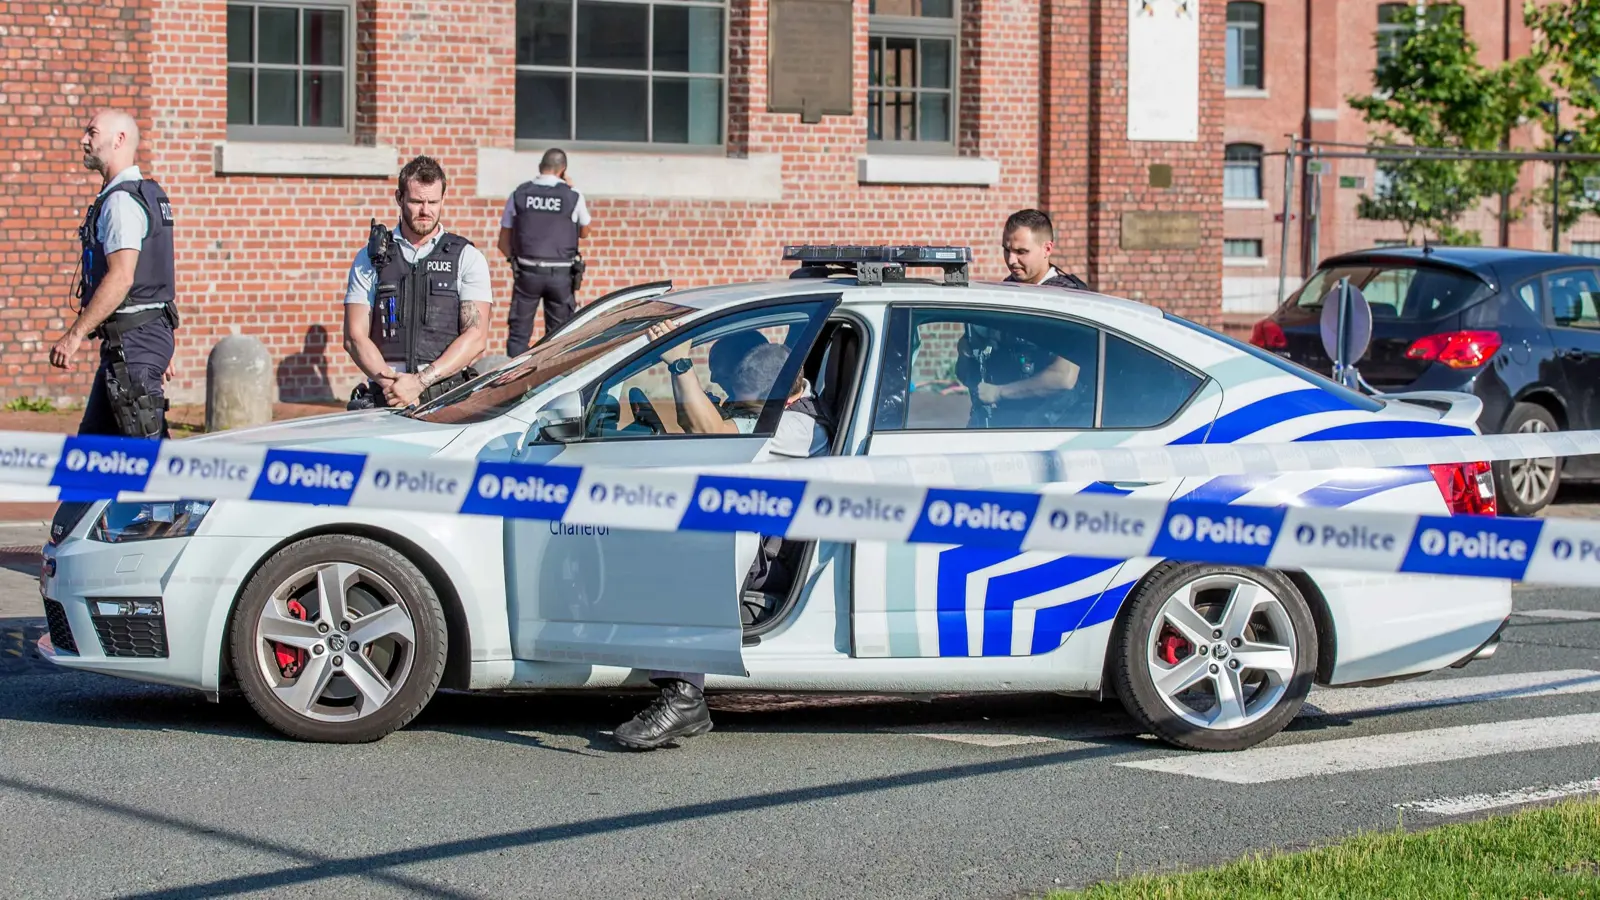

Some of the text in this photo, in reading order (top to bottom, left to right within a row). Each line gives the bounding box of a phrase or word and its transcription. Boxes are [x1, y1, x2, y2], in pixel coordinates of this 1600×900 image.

[526, 196, 561, 211] POLICE
[427, 261, 452, 272] POLICE
[0, 446, 49, 468] olice
[87, 449, 150, 476] Police
[189, 457, 248, 482] Police
[289, 461, 354, 490] Police
[396, 469, 459, 495] Police
[501, 475, 570, 504] Police
[612, 483, 678, 509] Police
[722, 489, 793, 518] Police
[839, 496, 906, 523] Police
[953, 501, 1028, 531] Police
[1075, 508, 1146, 536] Police
[1196, 515, 1272, 546] Police
[1321, 523, 1396, 552] Police
[1448, 529, 1528, 561] Police
